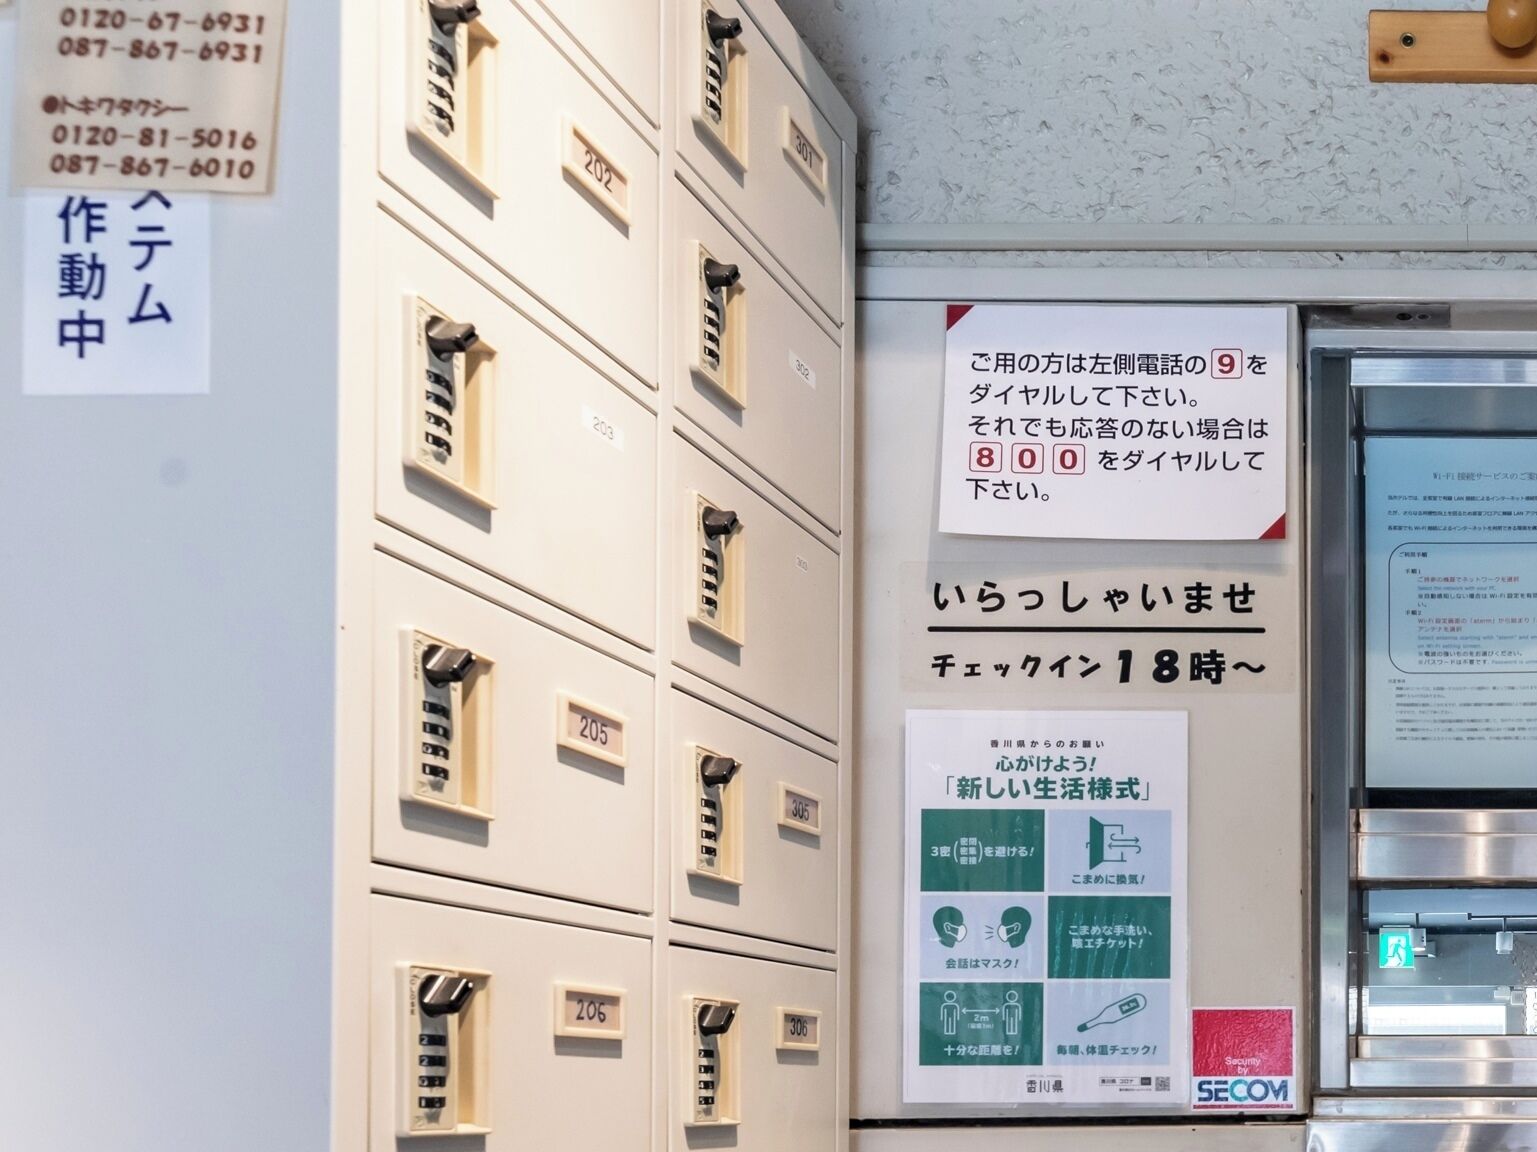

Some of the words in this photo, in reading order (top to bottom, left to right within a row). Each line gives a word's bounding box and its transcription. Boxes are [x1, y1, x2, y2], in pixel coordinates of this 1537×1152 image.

[60, 7, 265, 35] 0120-67-6931
[58, 37, 262, 63] 087-867-6931
[52, 125, 257, 151] 0120-81-5016
[796, 135, 812, 168] 301
[49, 154, 255, 179] 087-867-6010
[584, 150, 614, 193] 202
[57, 196, 108, 359] 作動中
[969, 384, 1199, 408] ダイヤルして下さい。
[592, 416, 615, 441] 203
[968, 416, 1269, 440] それでも応答のない場合は
[965, 478, 1050, 502] 下さい。
[933, 581, 1256, 614] いらっしゃいませ
[579, 715, 609, 745] 205
[990, 739, 1105, 749] 香川県からのお願い
[946, 776, 1150, 800] 「新しい生活様式」
[791, 799, 810, 821] 305
[575, 999, 607, 1023] 206
[790, 1017, 808, 1038] 306
[1224, 1056, 1262, 1067] Security
[1237, 1065, 1249, 1076] by
[1197, 1079, 1289, 1102] SECOM
